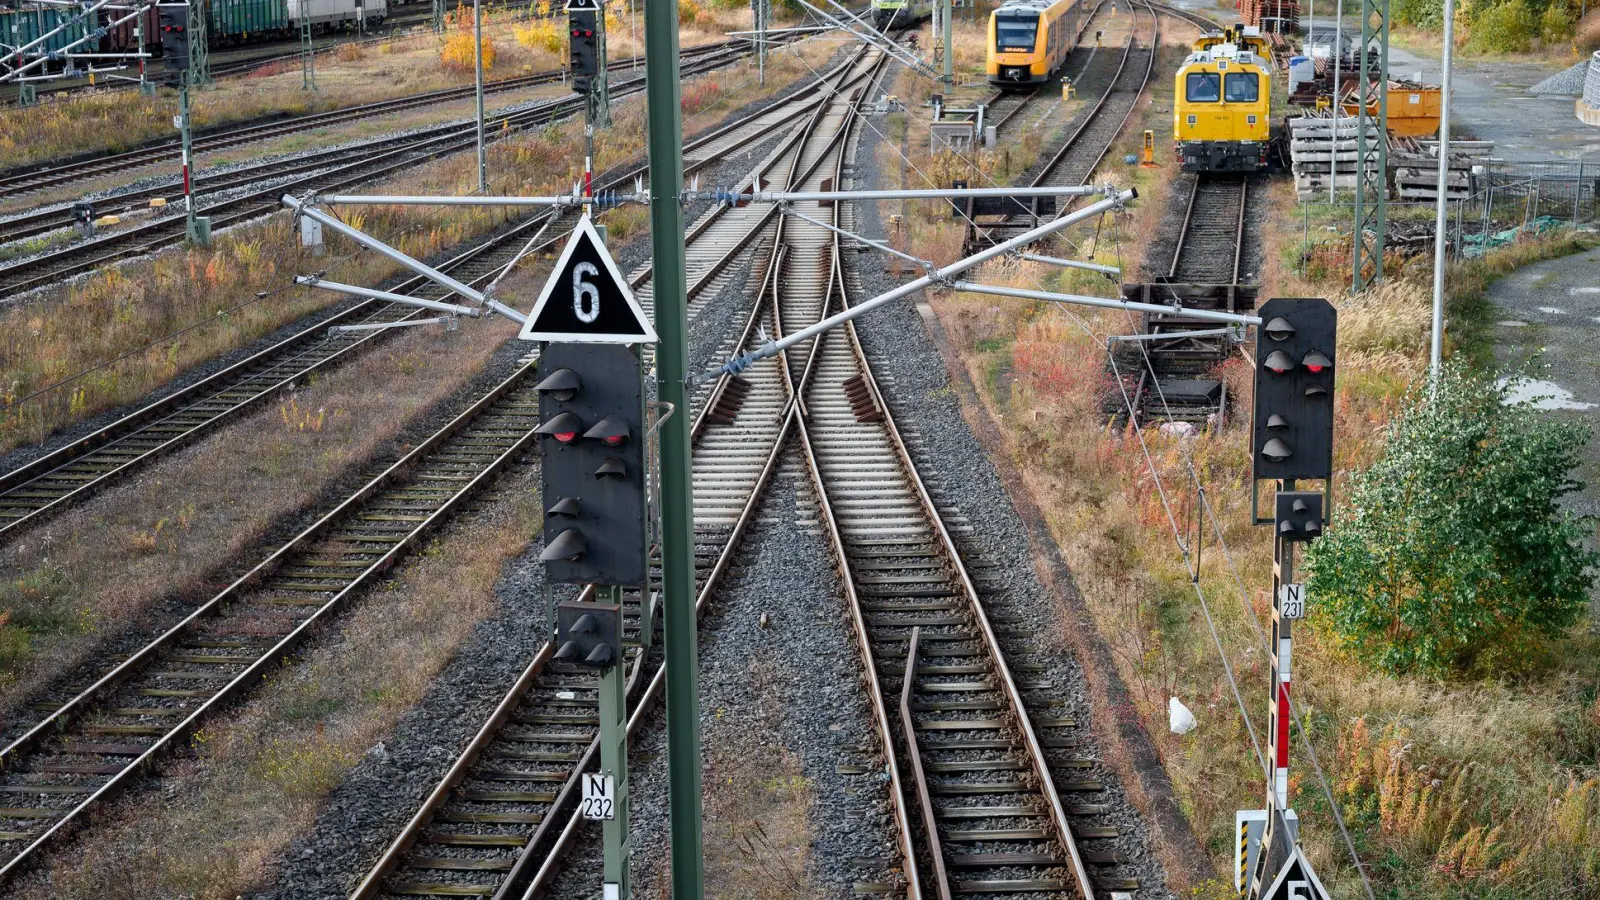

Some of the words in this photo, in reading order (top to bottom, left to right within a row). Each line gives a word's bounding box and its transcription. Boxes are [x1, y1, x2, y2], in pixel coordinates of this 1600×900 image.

[573, 261, 600, 324] 6
[1287, 586, 1299, 601] N
[1283, 602, 1303, 617] 231
[591, 777, 606, 797] N
[584, 798, 612, 817] 232
